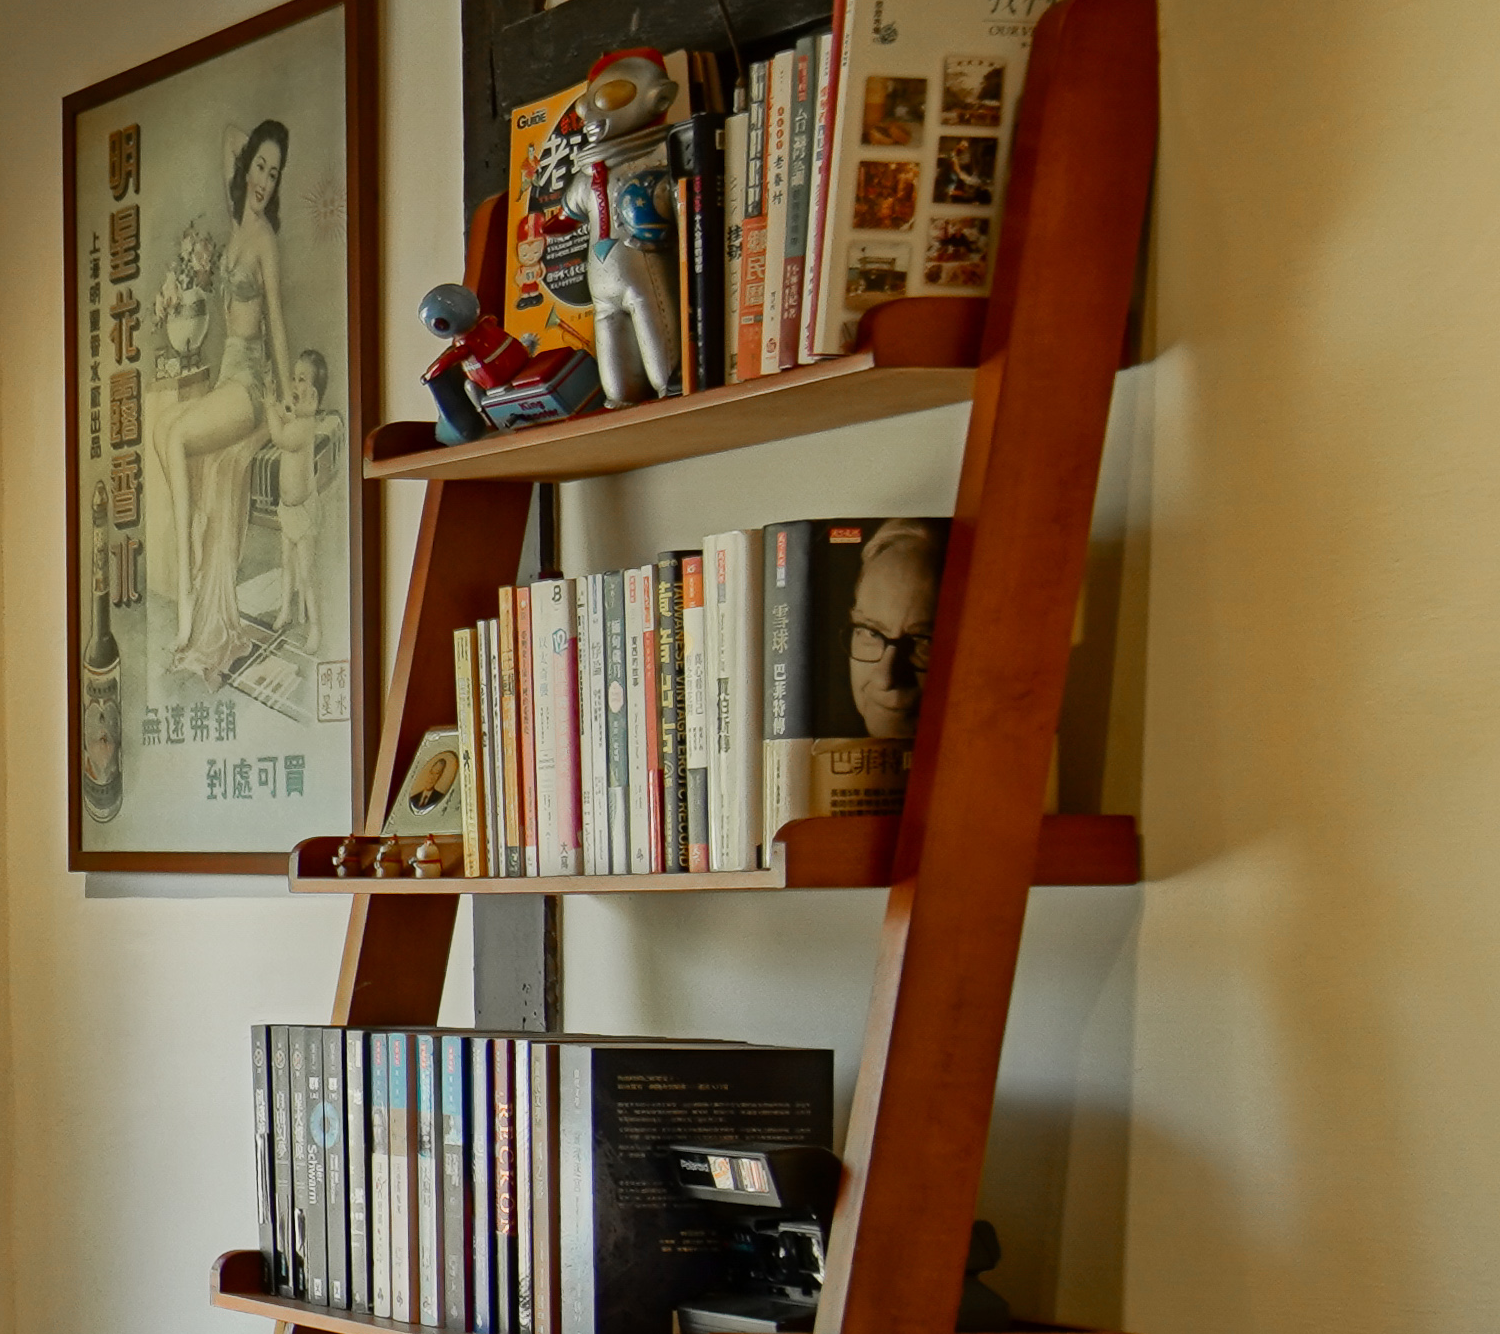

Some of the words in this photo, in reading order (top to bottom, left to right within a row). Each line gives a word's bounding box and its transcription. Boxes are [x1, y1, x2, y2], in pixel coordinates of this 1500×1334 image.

[516, 114, 547, 130] GUIDE
[109, 122, 143, 607] 明星花露香水
[675, 581, 686, 663] TAIWANESE
[771, 603, 789, 655] 雪球
[676, 670, 687, 734] VINTAGE
[772, 663, 787, 736] 巴菲特傳
[205, 754, 306, 801] 到處可買
[678, 804, 689, 868] RECORD
[308, 1143, 318, 1205] Schwarm
